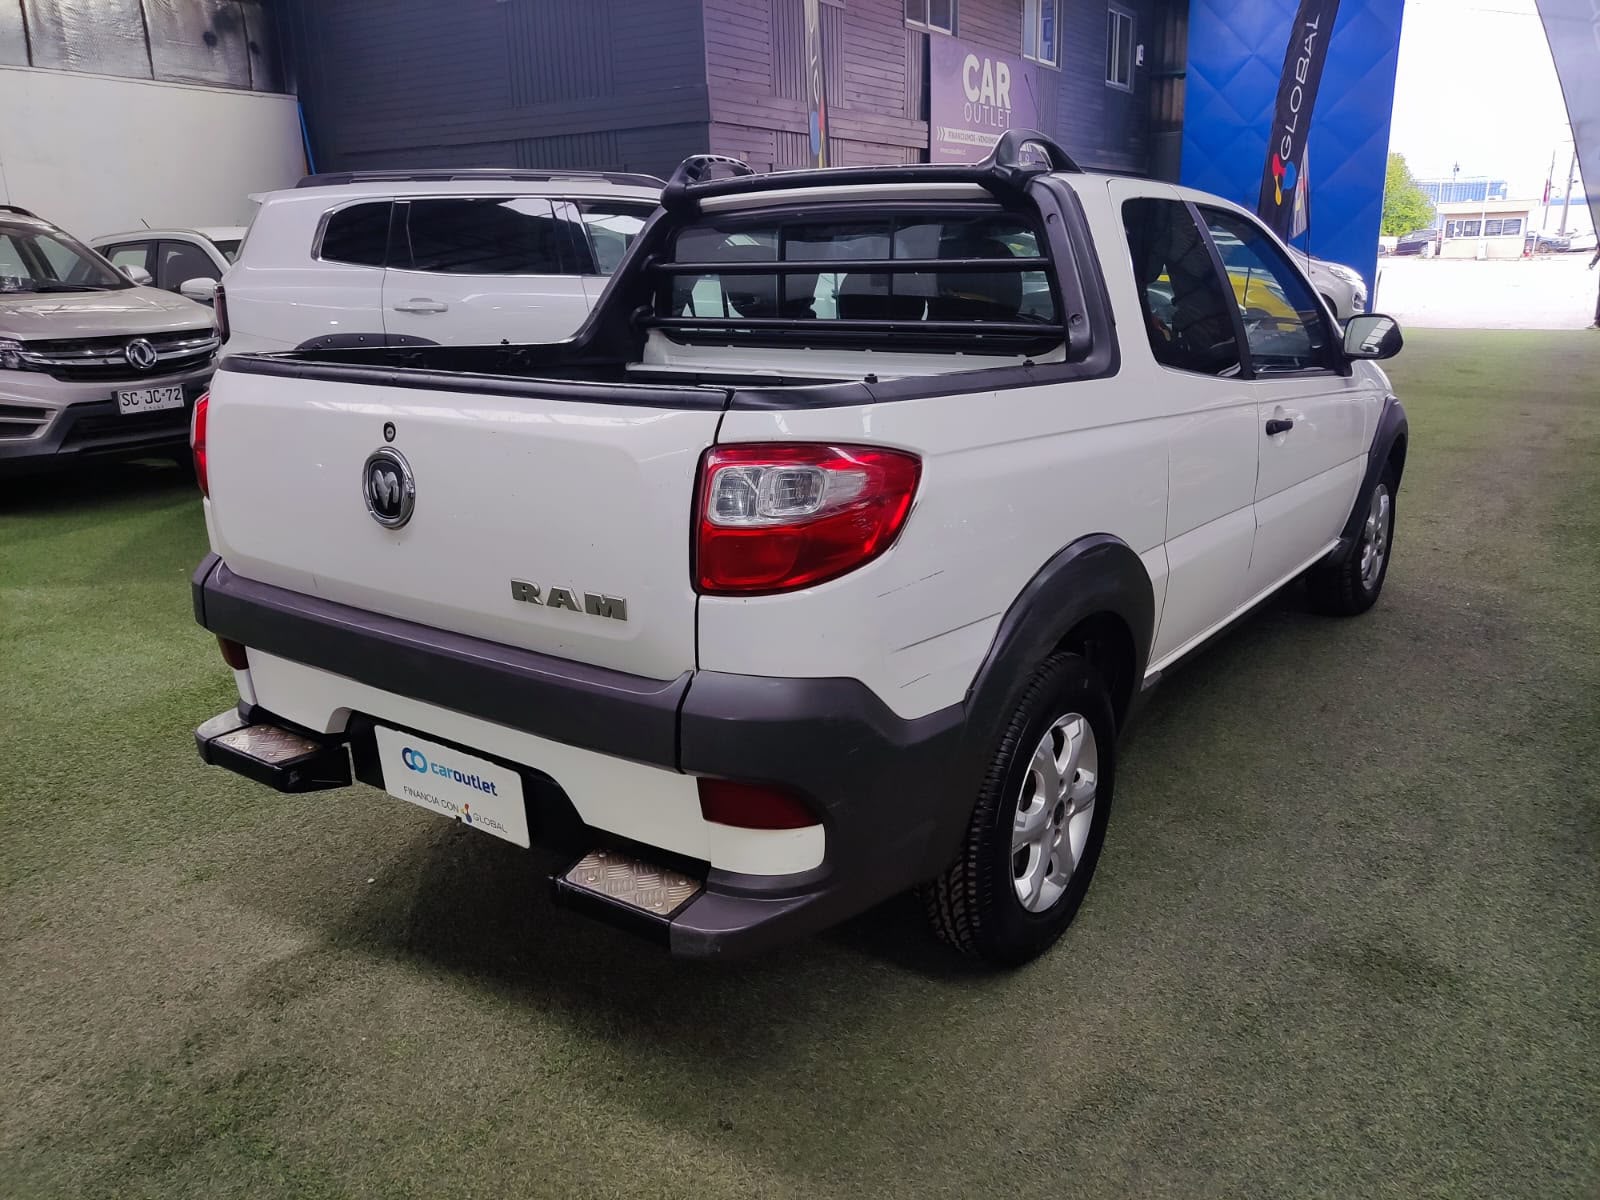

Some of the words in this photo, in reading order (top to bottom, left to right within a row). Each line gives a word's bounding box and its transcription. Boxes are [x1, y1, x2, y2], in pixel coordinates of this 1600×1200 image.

[962, 53, 1012, 110] CAR
[1280, 13, 1321, 161] GLOBAL
[963, 102, 1012, 129] OUTLET
[510, 579, 628, 621] RAM
[430, 762, 498, 797] caroutlet
[403, 785, 440, 805] FINANCIA
[441, 799, 460, 814] CON
[472, 812, 509, 834] GLOBAL
